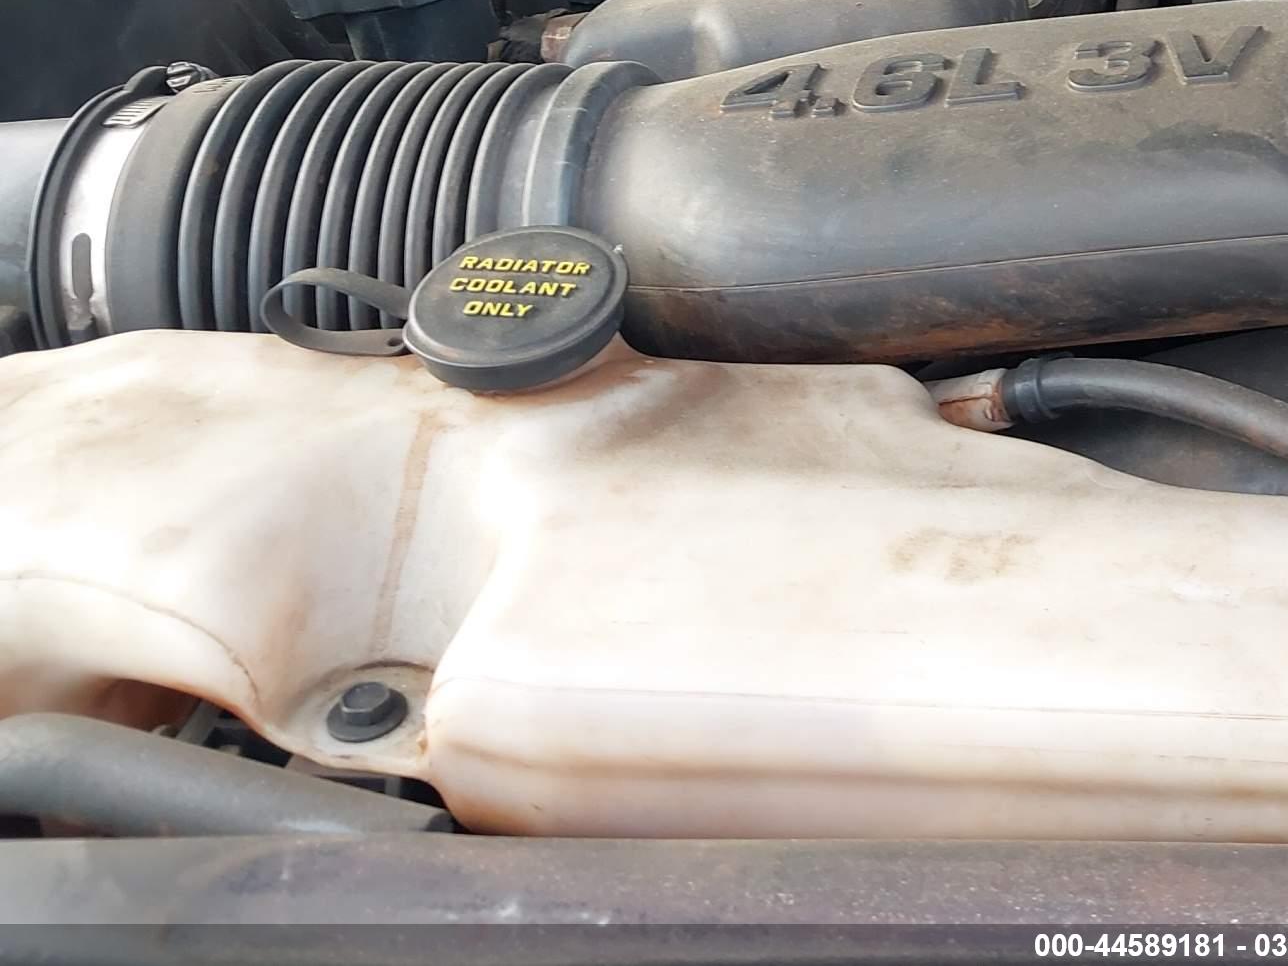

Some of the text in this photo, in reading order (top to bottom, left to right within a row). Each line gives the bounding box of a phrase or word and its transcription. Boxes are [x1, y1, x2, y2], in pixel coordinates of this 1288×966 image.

[719, 25, 1269, 119] 4.6L 3V
[459, 256, 593, 275] RADIATOR
[449, 277, 578, 297] COOLANT
[462, 300, 534, 318] ONLY
